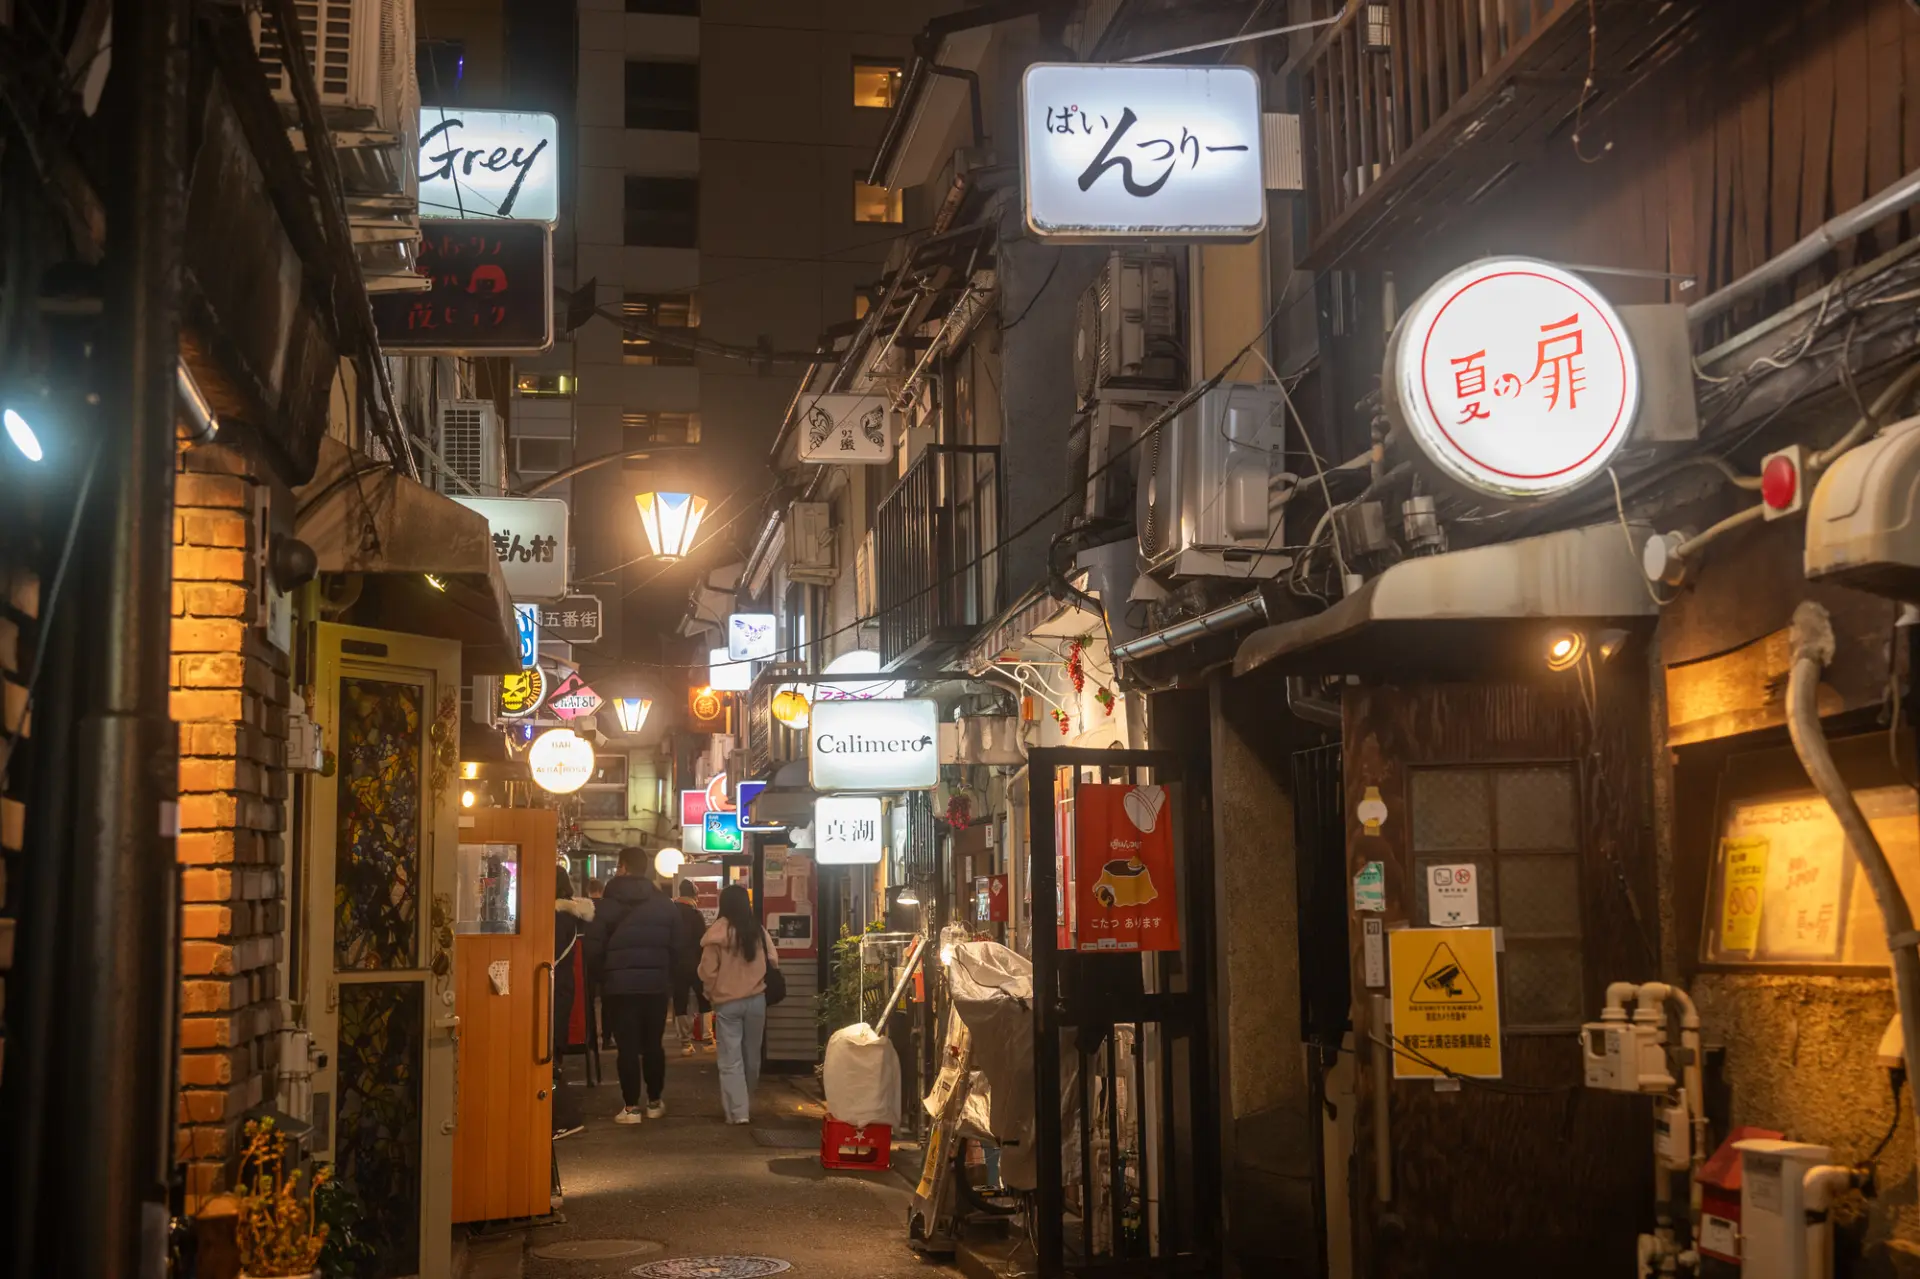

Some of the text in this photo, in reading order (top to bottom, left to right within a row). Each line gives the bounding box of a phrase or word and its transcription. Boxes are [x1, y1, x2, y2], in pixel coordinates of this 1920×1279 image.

[420, 119, 548, 216] Grey
[1046, 105, 1249, 198] ぱいんつりー
[1450, 312, 1587, 425] 夏の扉
[493, 529, 558, 563] ぎん村
[816, 734, 924, 754] Calimero
[1091, 917, 1162, 929] こたつ あります
